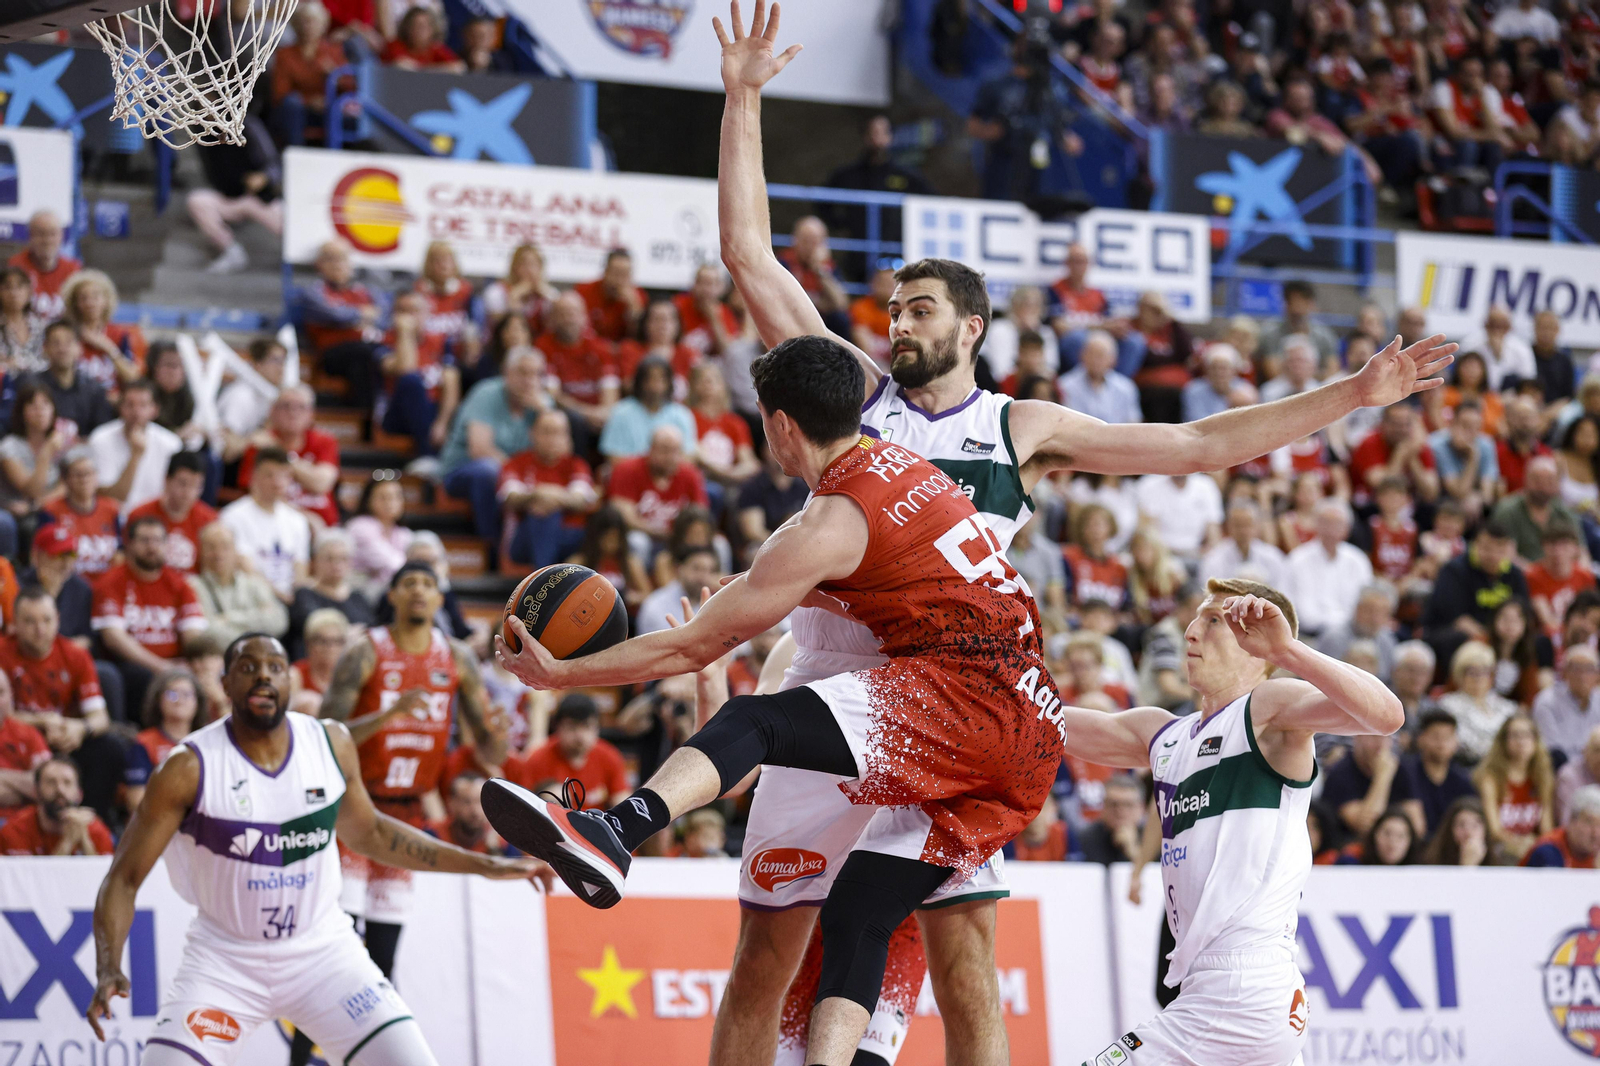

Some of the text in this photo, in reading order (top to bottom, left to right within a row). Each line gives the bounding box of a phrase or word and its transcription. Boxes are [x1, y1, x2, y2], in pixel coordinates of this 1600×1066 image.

[427, 182, 627, 219] CATALANA
[427, 212, 626, 251] DE TREBALL
[1163, 789, 1210, 818] Unicaja
[264, 827, 330, 852] Unicaja
[752, 851, 824, 878] famadesa
[261, 905, 296, 940] 34
[0, 910, 158, 1019] XI
[1547, 965, 1600, 1006] BA
[1122, 1035, 1135, 1048] acb
